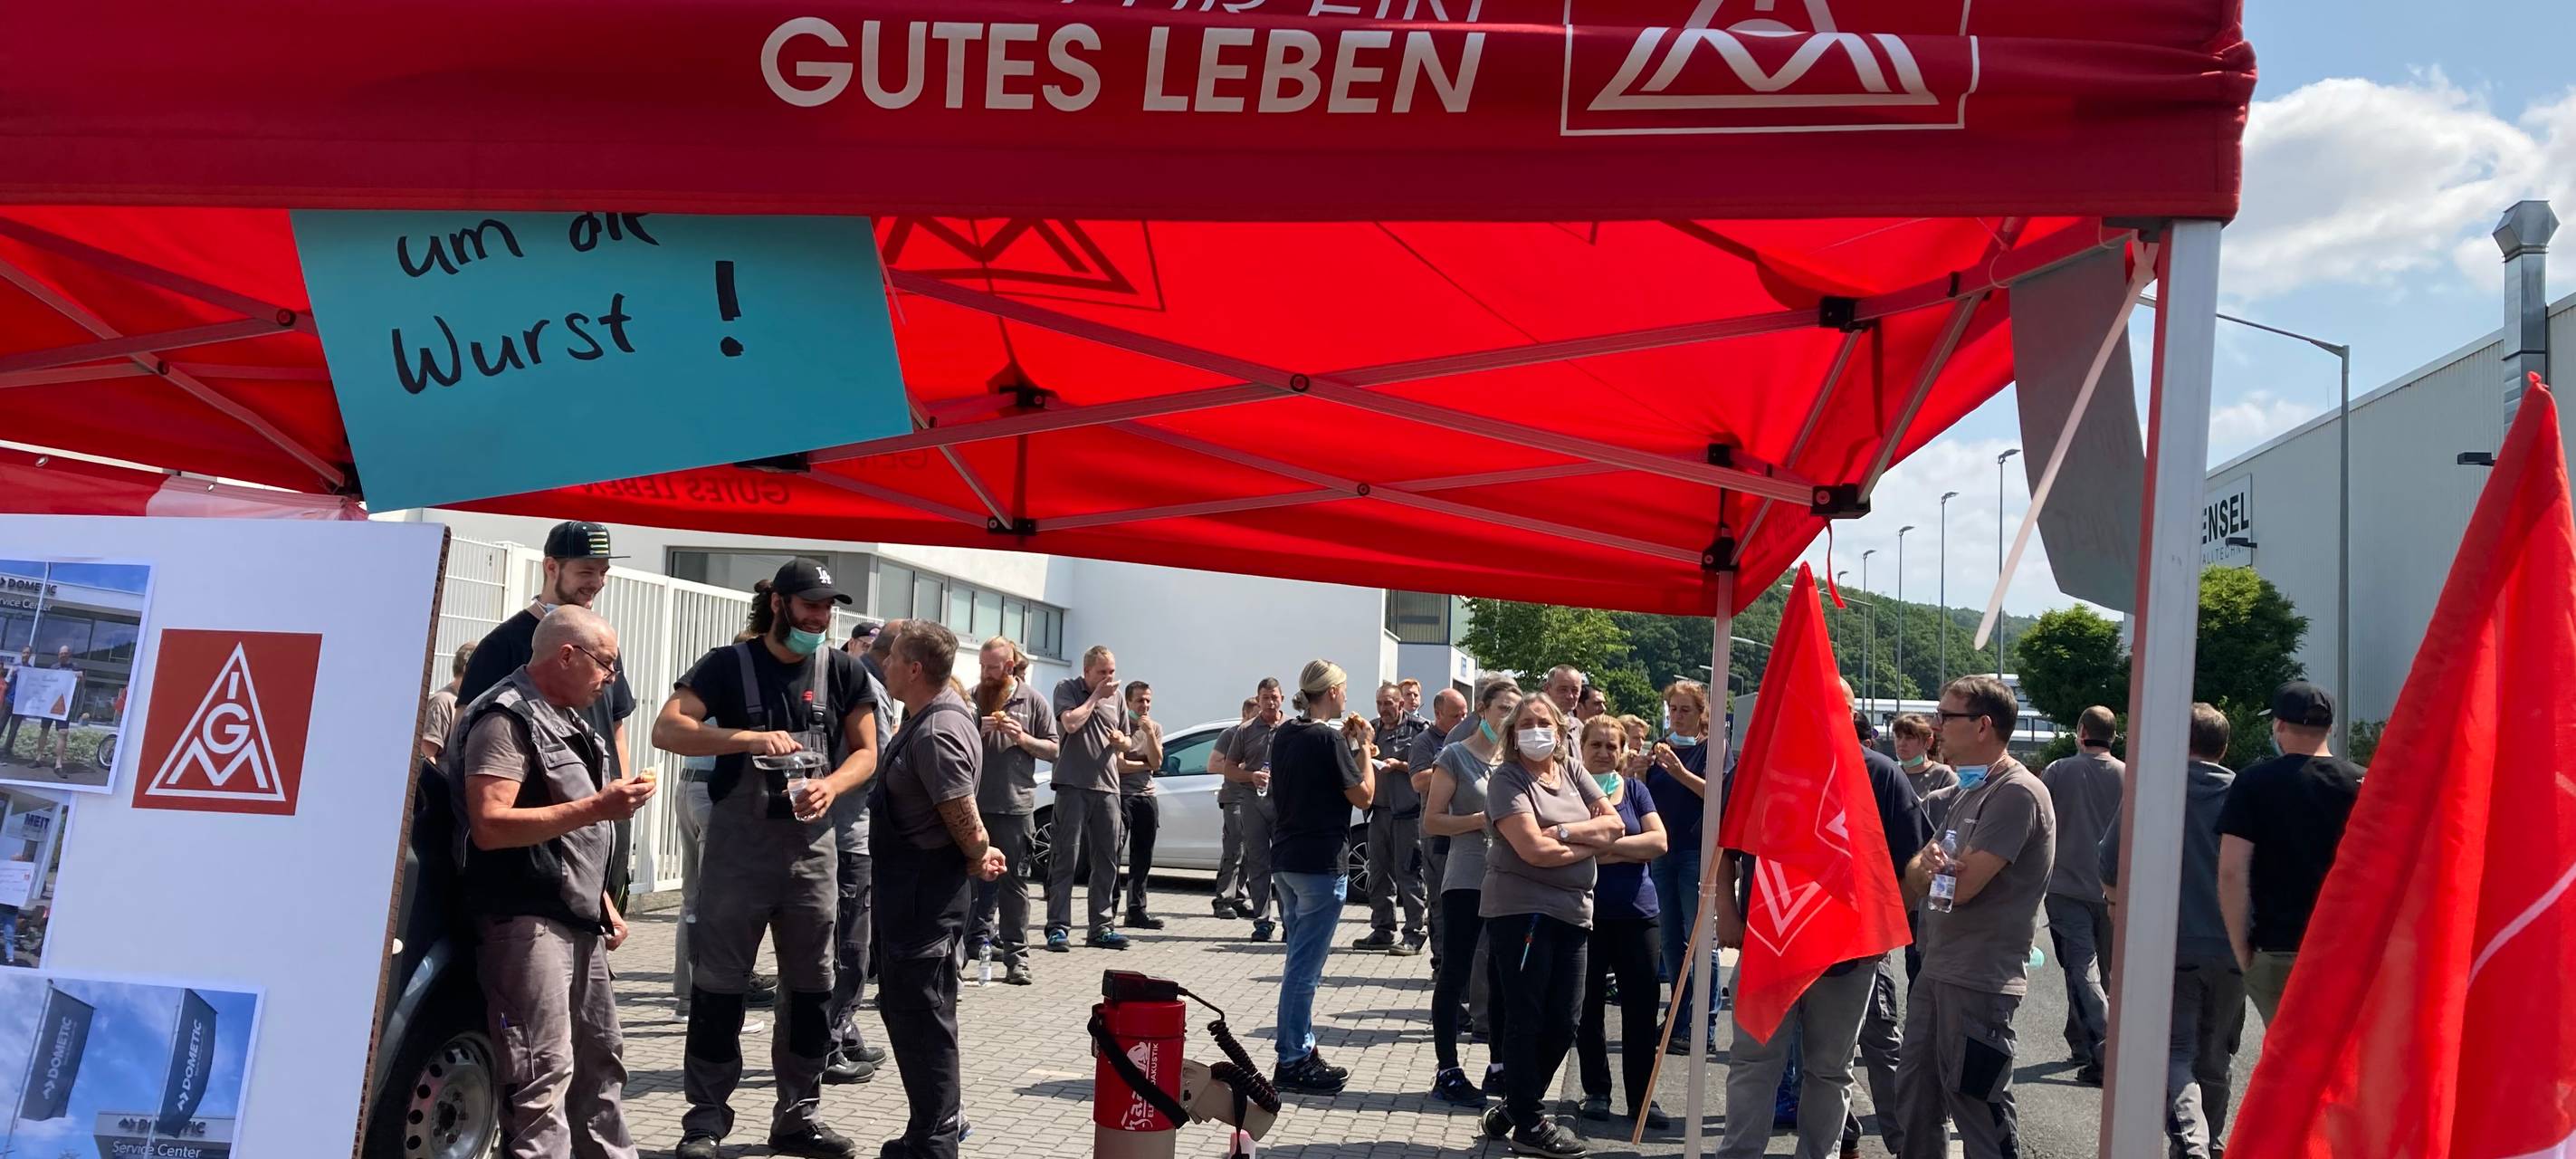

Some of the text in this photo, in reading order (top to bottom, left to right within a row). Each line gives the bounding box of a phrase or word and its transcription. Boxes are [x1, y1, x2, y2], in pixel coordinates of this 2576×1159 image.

[760, 16, 1486, 114] GUTES LEBEN
[396, 219, 524, 278] um
[391, 292, 635, 395] Wurst
[7, 578, 58, 597] DOMEIC
[816, 566, 832, 585] LA
[49, 1016, 72, 1080] DOMETIC
[181, 1018, 203, 1091] DOMETIC
[157, 1143, 203, 1159] Center
